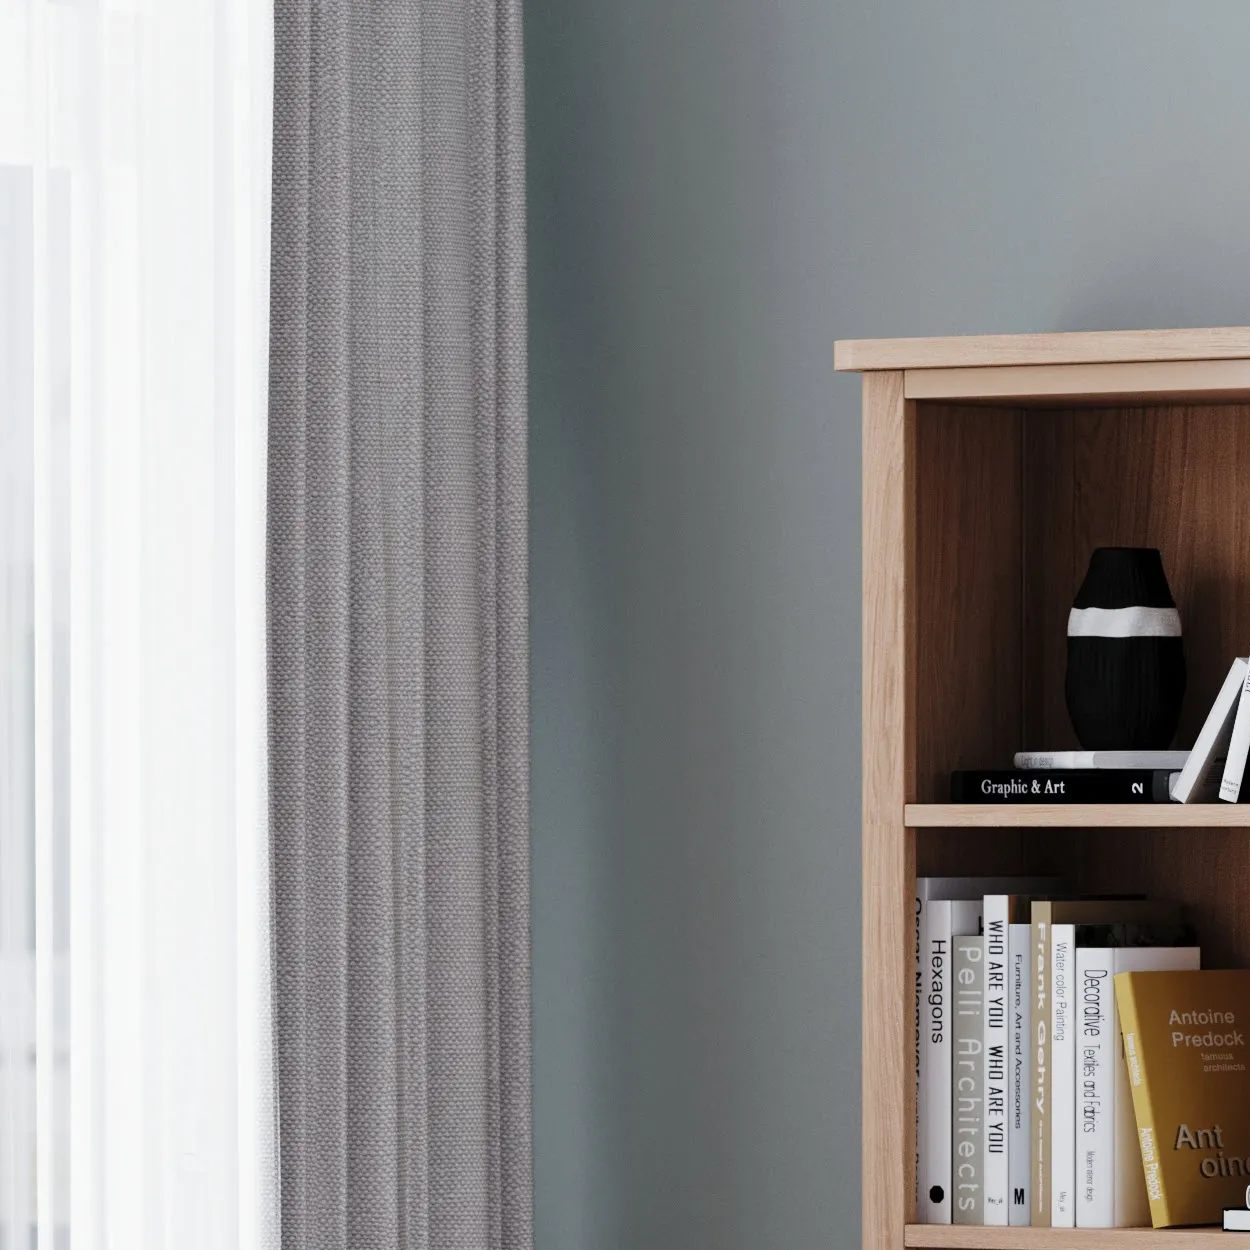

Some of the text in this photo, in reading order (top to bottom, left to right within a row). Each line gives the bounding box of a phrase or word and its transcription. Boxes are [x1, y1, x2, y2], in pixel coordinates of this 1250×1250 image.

[981, 778, 1066, 798] Graphic & Art
[1131, 782, 1143, 795] 2
[928, 940, 947, 1044] Hexagons
[989, 920, 1004, 1028] WHO ARE YOU
[1036, 922, 1047, 1115] Frank Gehry
[1053, 942, 1068, 1041] Water color Painting
[1168, 1009, 1235, 1027] Antoine
[957, 947, 983, 1211] Pelli Architects
[1014, 954, 1023, 1129] Furniture, Art and Accessories
[1083, 969, 1108, 1133] Decorative Textiles and Fabrics
[1171, 1031, 1245, 1047] Predock
[989, 1045, 1004, 1154] WHO ARE YOU
[1174, 1123, 1225, 1152] Ant
[1014, 1188, 1025, 1205] M
[1140, 1127, 1164, 1201] Antoine Predock
